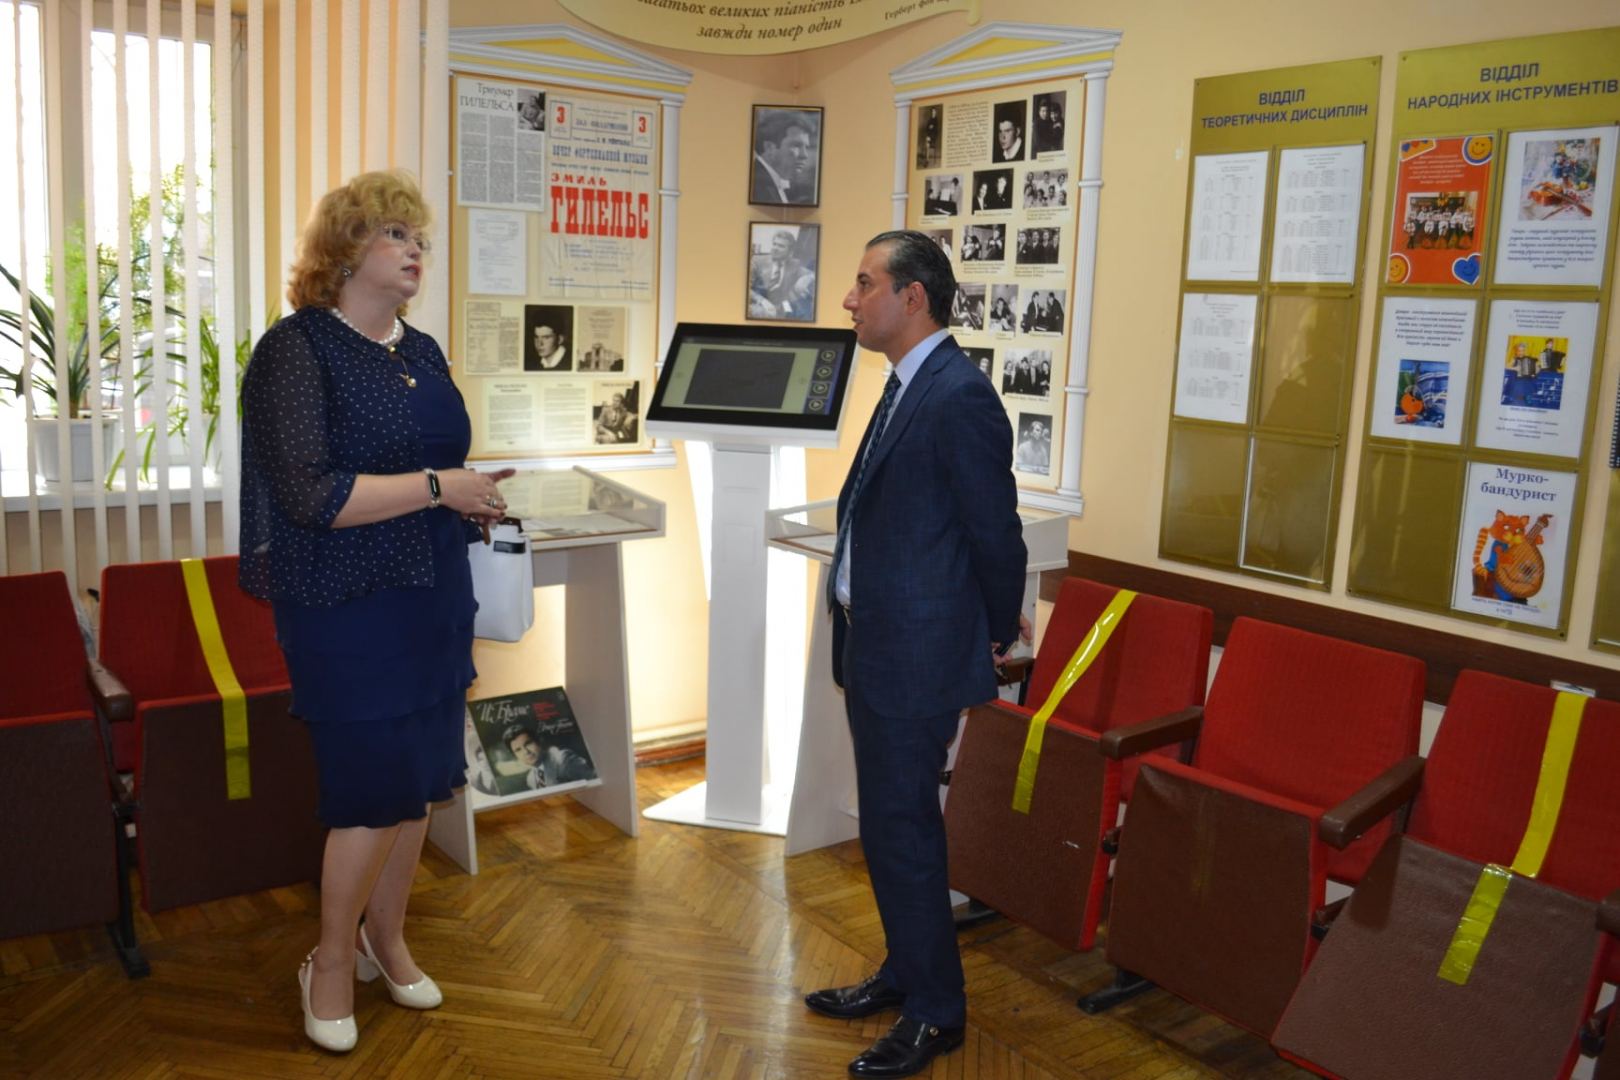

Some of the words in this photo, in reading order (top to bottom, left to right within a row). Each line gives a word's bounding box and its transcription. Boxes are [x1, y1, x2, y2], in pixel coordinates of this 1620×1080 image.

[709, 7, 770, 17] великих
[697, 24, 753, 39] завжди
[757, 26, 803, 41] номер
[808, 16, 842, 34] один
[1480, 63, 1539, 84] ВІДДІЛ
[1259, 88, 1306, 107] ВІДДІЛ
[1408, 90, 1491, 110] НАРОДНИХ
[1496, 79, 1618, 102] ІНСТРУМЕНТІВ
[556, 106, 565, 124] 3
[638, 116, 647, 133] 3
[1201, 110, 1287, 129] ТЕОРЕТИЧНИХ
[1290, 104, 1368, 124] ДИСЦИПЛІН
[551, 172, 608, 186] ЭМИЛЬ
[550, 185, 649, 239] ГИЛЕЛЬС
[1496, 468, 1549, 484] Мурко-
[1480, 482, 1557, 502] бандурист
